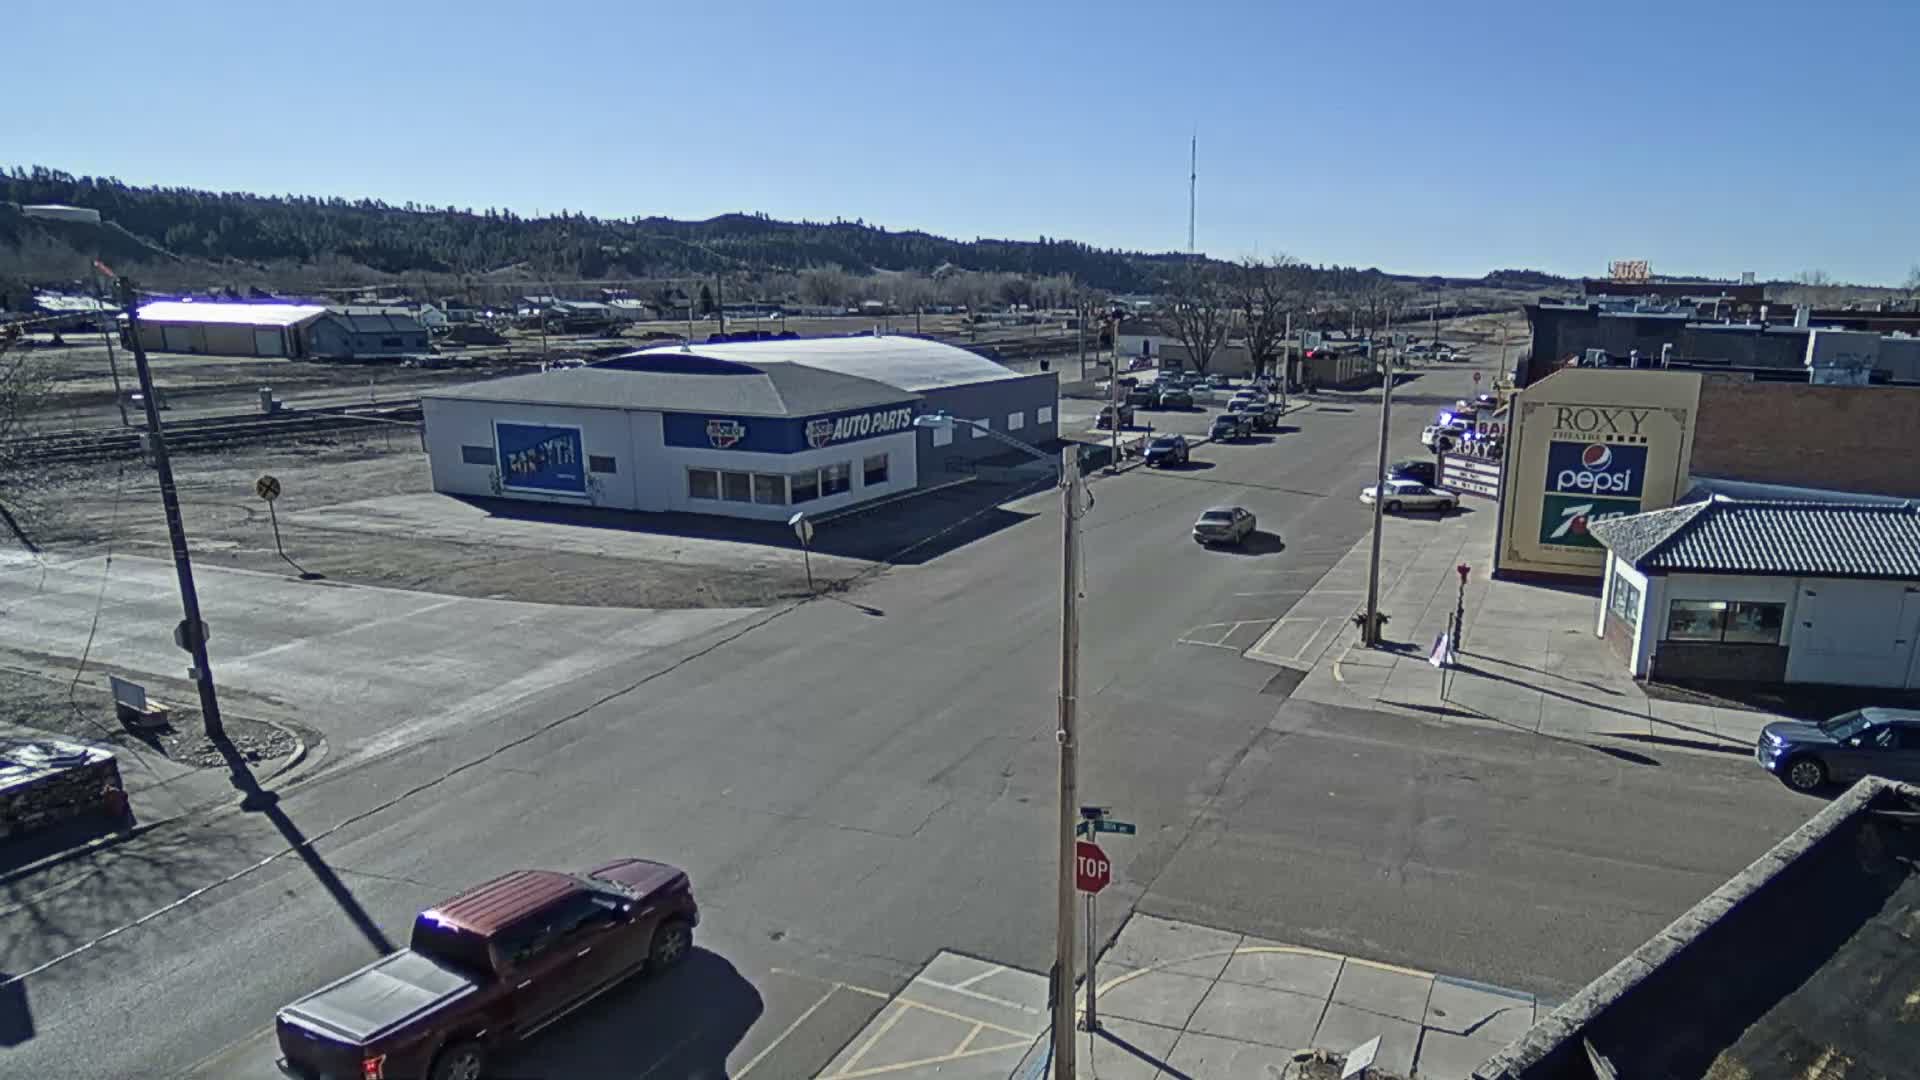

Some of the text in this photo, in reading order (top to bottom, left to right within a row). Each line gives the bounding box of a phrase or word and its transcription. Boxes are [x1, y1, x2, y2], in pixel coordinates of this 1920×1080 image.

[831, 413, 871, 440] AUTO
[870, 408, 912, 433] PARTS
[1552, 407, 1648, 434] ROXY
[1557, 469, 1632, 494] pepsi
[1078, 856, 1109, 879] TOP
